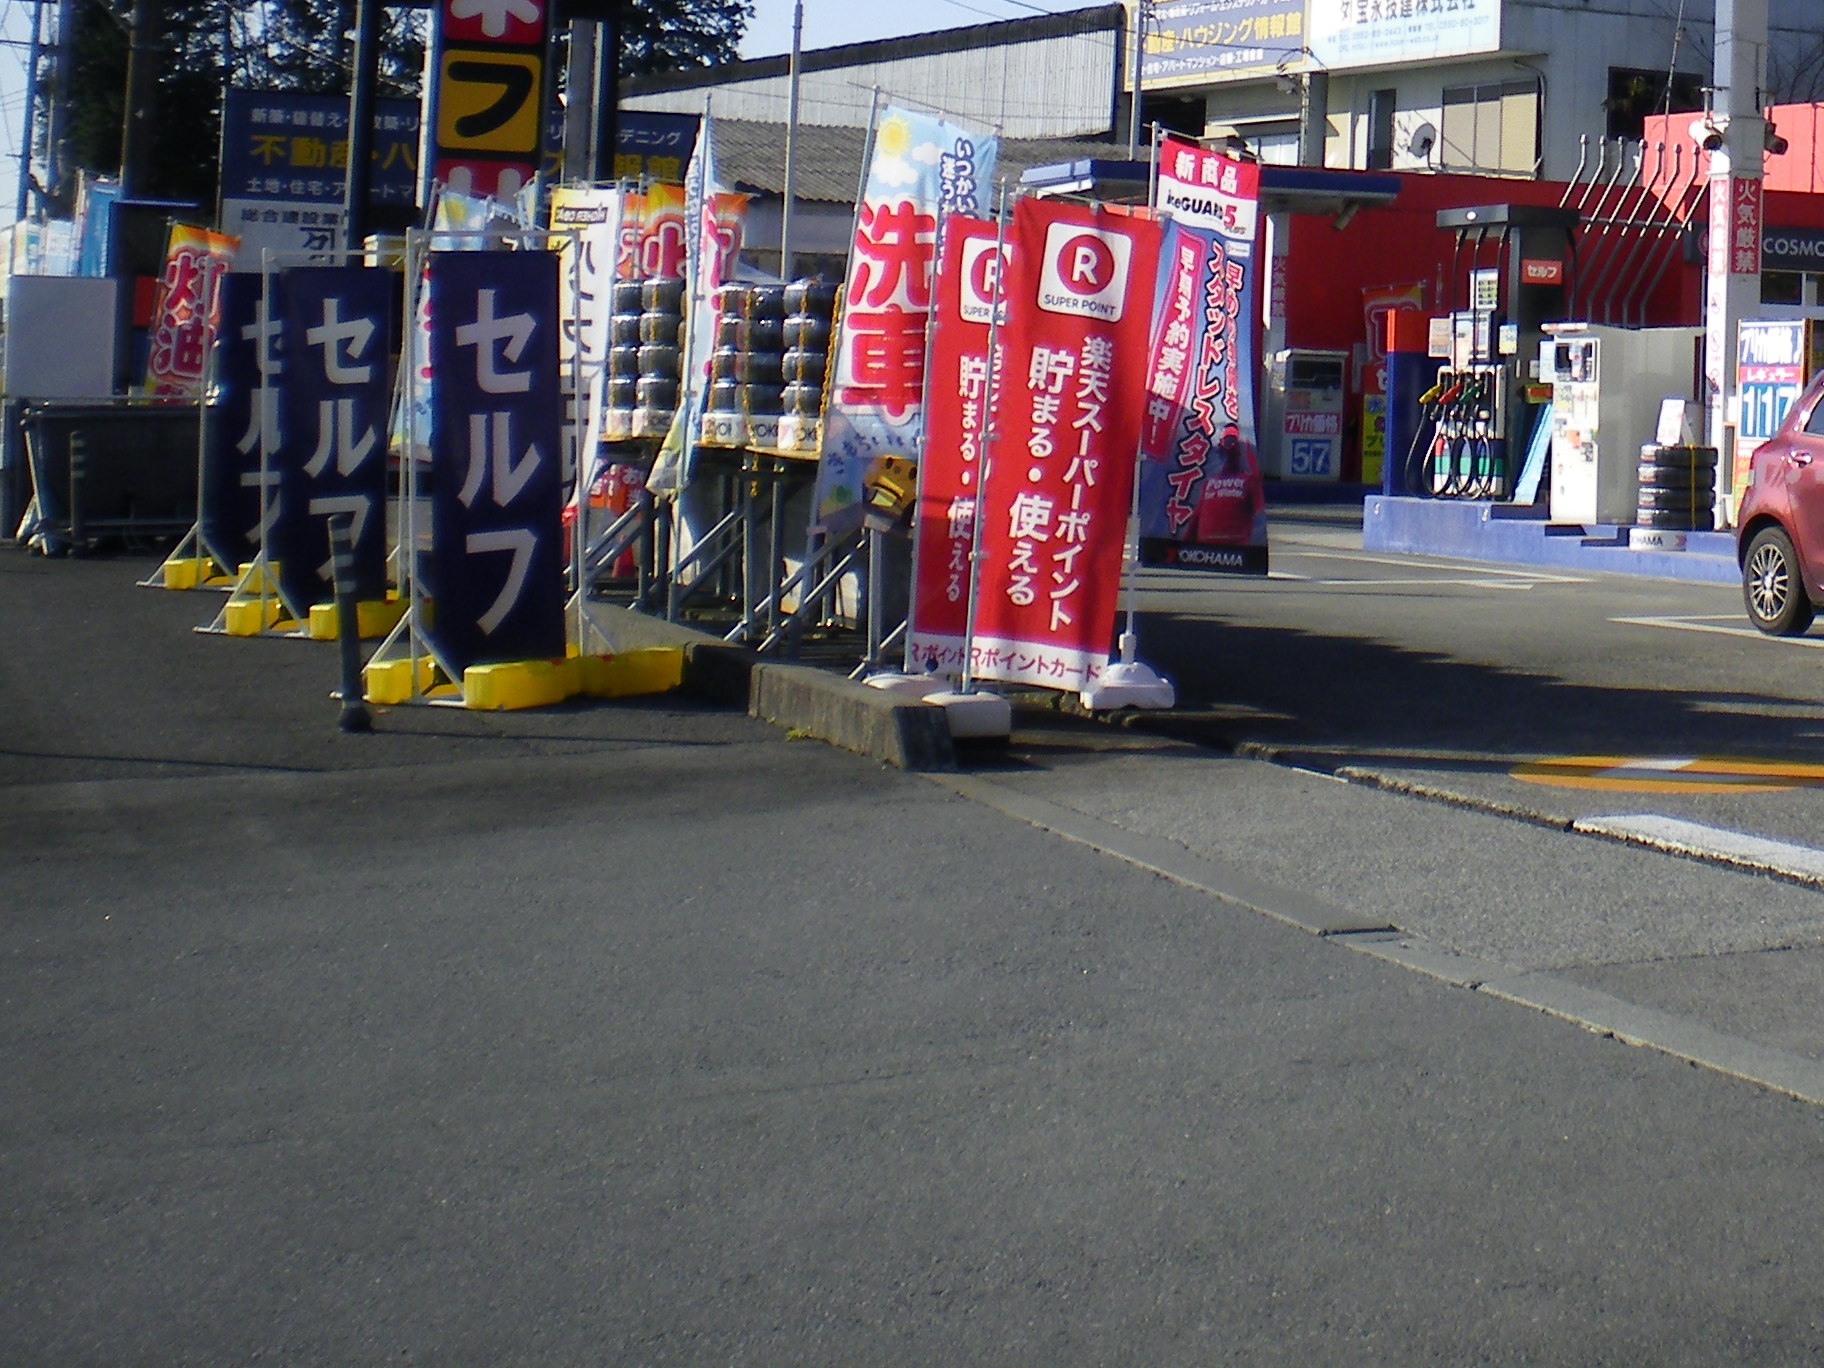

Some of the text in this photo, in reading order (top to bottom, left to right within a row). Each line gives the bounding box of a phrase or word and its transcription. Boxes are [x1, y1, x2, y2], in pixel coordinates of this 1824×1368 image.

[1134, 11, 1303, 55] 動産・ハウジング情報館
[1174, 150, 1238, 194] 新商品
[1735, 184, 1758, 272] 火気厳禁
[1071, 245, 1099, 286] R
[1526, 264, 1558, 279] セルフ
[837, 200, 939, 420] 洗車
[1044, 294, 1117, 317] SUPER POINT
[1166, 240, 1226, 535] スタッドレスタイヤ
[1742, 385, 1797, 435] 117
[303, 298, 377, 581] セルフ
[456, 289, 541, 636] セルフ
[1292, 441, 1330, 473] 57
[1005, 346, 1075, 607] 貯まる・使える
[1048, 336, 1113, 633] 楽天スーパーポイント
[1205, 478, 1246, 492] Power
[970, 645, 1102, 683] Rポイントカード
